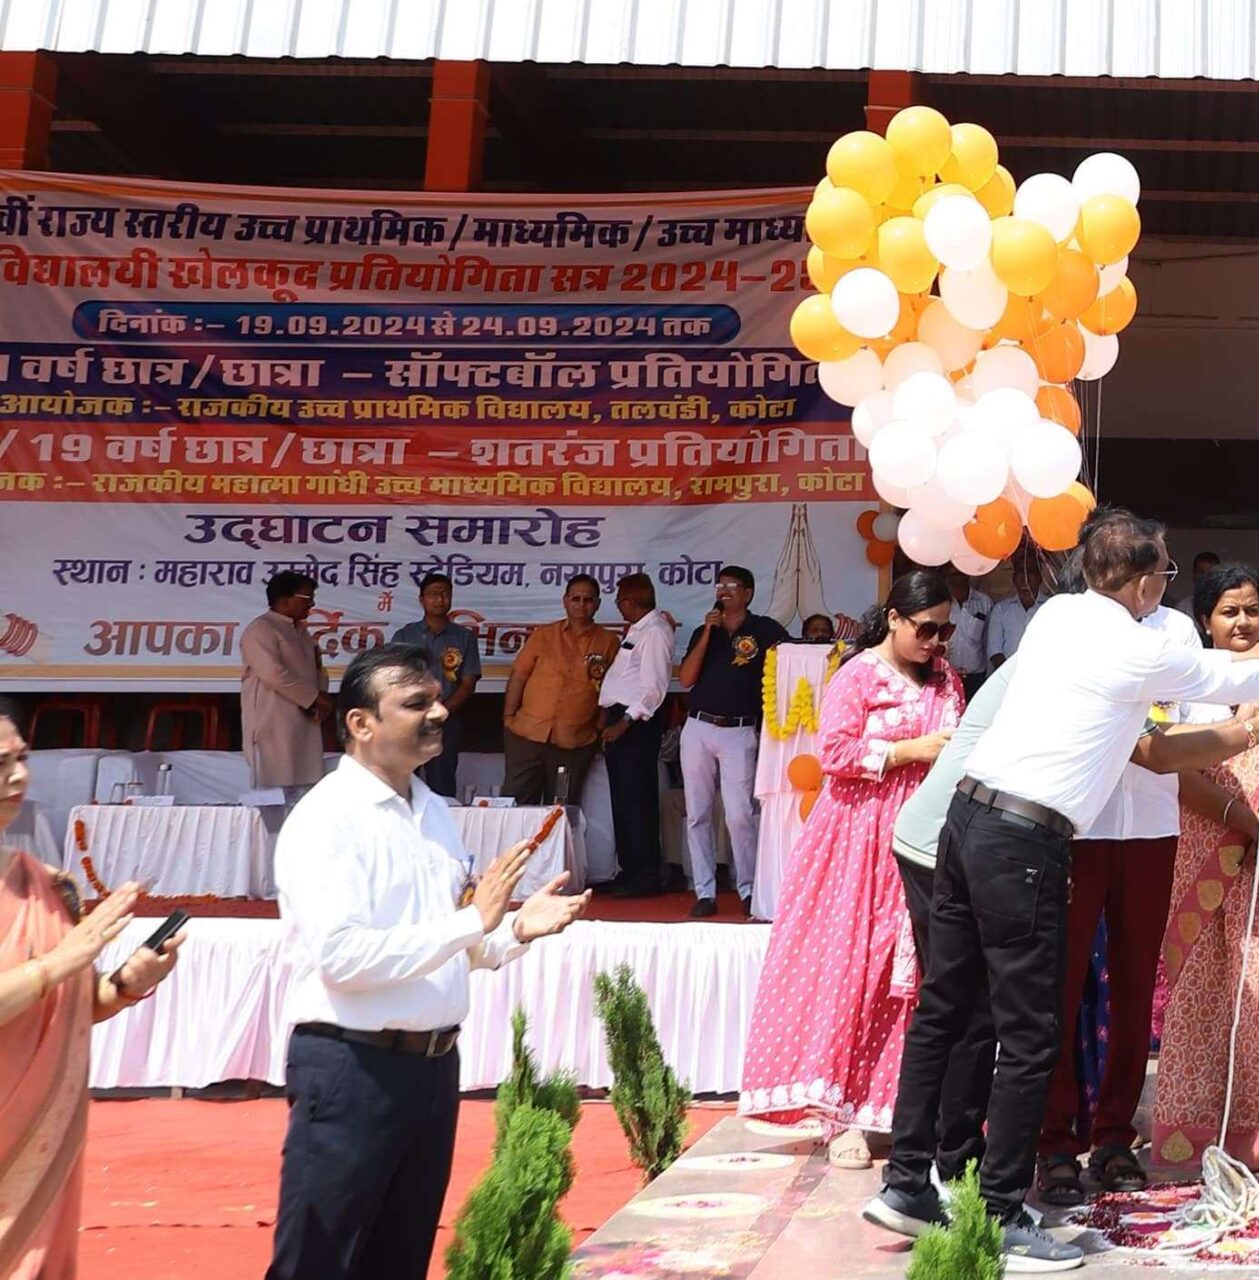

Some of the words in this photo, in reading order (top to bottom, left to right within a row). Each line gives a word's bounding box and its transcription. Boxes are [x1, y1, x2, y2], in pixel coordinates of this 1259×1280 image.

[38, 206, 120, 238] राज्य
[124, 202, 232, 241] स्तरीय
[234, 214, 301, 244] उच्च
[723, 216, 812, 246] माध्य
[168, 248, 324, 303] खेलकूद
[329, 253, 546, 293] प्रतियोगिता
[550, 263, 615, 293] सत्र
[98, 308, 188, 335] दिनांक
[235, 315, 426, 337] 19.09.2024
[431, 311, 456, 337] से
[462, 315, 657, 337] 24.09.2024
[662, 317, 713, 337] तक
[20, 348, 95, 384] वर्ष
[385, 351, 601, 388] सॉफ्टबॉल
[0, 389, 136, 416] आयोजक
[177, 393, 293, 418] राजकीय
[298, 399, 346, 419] उच्च
[352, 395, 471, 420] प्राथमिक
[729, 393, 797, 419] कोटा
[105, 427, 177, 464] वर्ष
[471, 429, 621, 467] शतरंज
[627, 427, 869, 468] प्रतियोगिता
[92, 470, 206, 494] राजकीय
[210, 474, 302, 496] महात्मा
[305, 469, 369, 496] गांधी
[373, 475, 423, 497] उच्च
[428, 472, 557, 497] माध्यमिक
[797, 467, 866, 493] कोटा
[404, 507, 606, 547] समारोह
[154, 559, 256, 588] महाराव
[348, 552, 402, 588] सिंह
[377, 591, 395, 613] में
[84, 619, 241, 657] आपका
